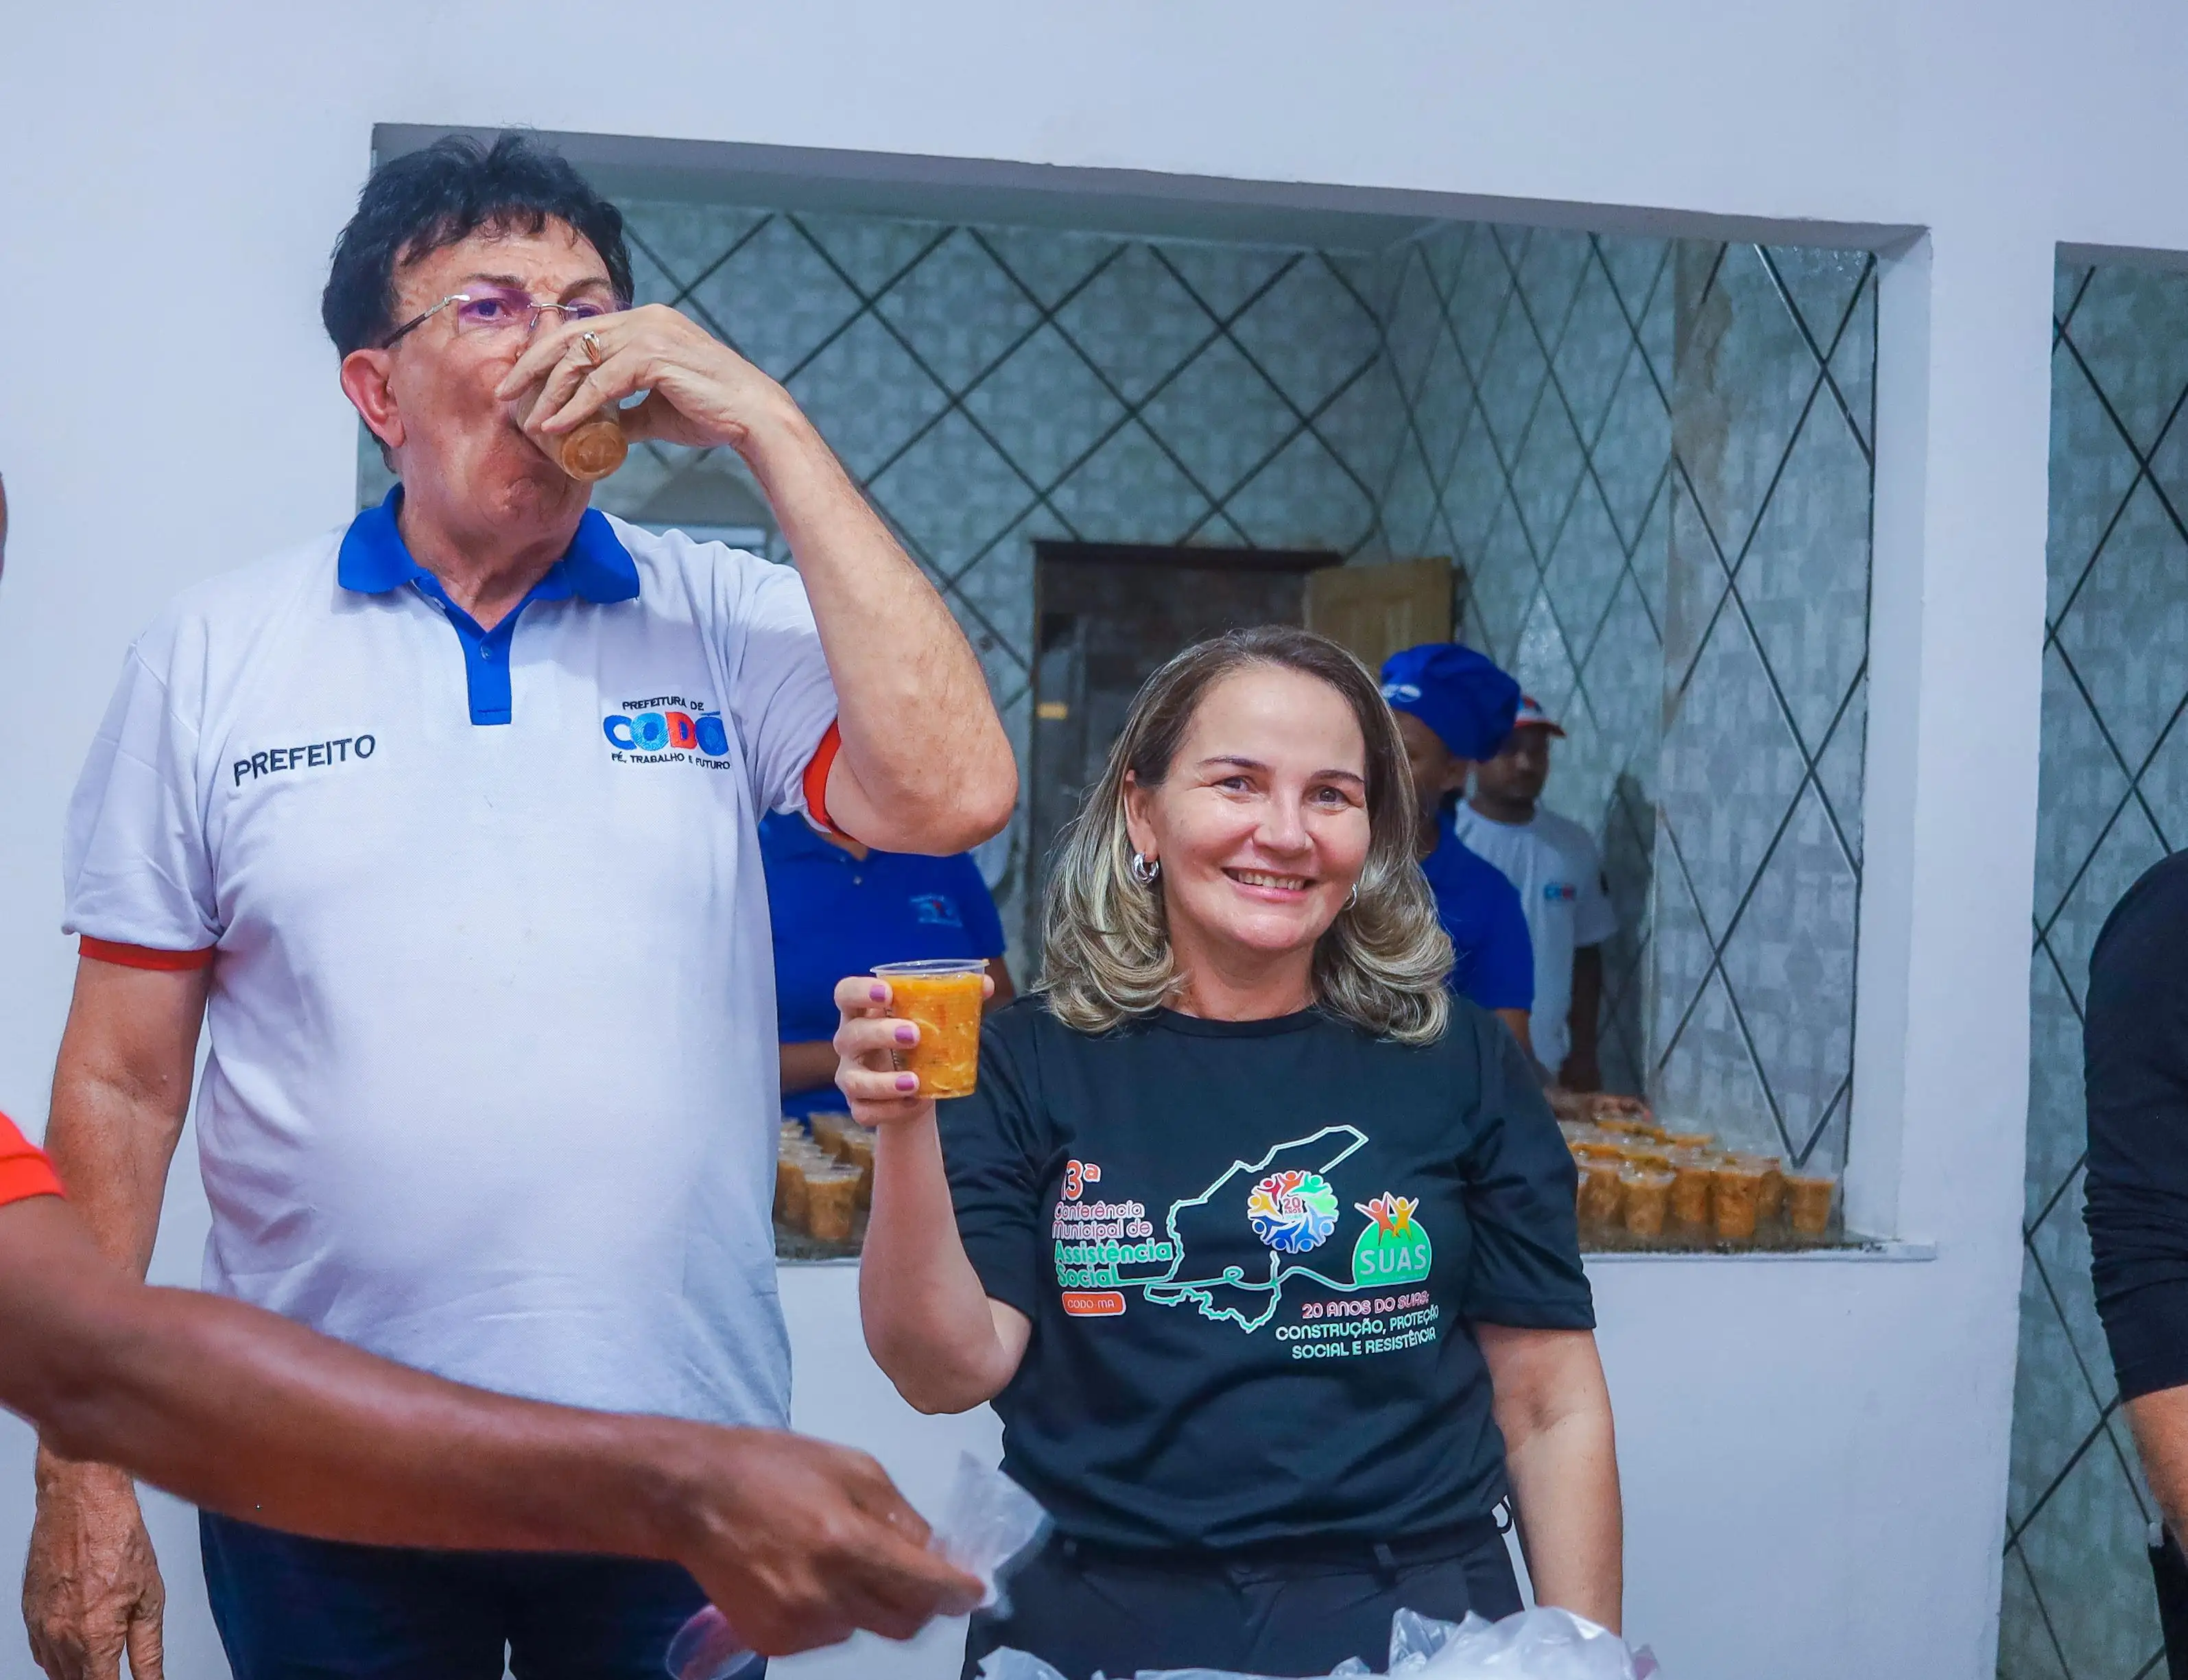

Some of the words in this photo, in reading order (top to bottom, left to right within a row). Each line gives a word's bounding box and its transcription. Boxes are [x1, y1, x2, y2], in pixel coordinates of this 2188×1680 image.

[622, 696, 687, 710] PREFEITURA
[691, 701, 704, 711] DE
[233, 735, 376, 787] PREFEITO
[630, 753, 685, 764] TRABALHO
[695, 757, 730, 770] FUTURO
[1054, 1200, 1145, 1221] Conferência
[1052, 1219, 1124, 1242] Municipal
[1126, 1218, 1153, 1238] de
[1054, 1237, 1174, 1264] Assistência
[1360, 1244, 1427, 1275] SUAS
[1056, 1262, 1119, 1288] Social
[1302, 1303, 1323, 1318] 20
[1327, 1300, 1371, 1317] ANOS
[1375, 1297, 1395, 1314] DO
[1275, 1317, 1386, 1340] CONSTRUÇÃO,
[1390, 1304, 1439, 1331] PROTEÇÃO
[1292, 1342, 1350, 1359] SOCIAL
[1352, 1340, 1361, 1355] E
[1365, 1326, 1436, 1354] RESISTÊNCIA
